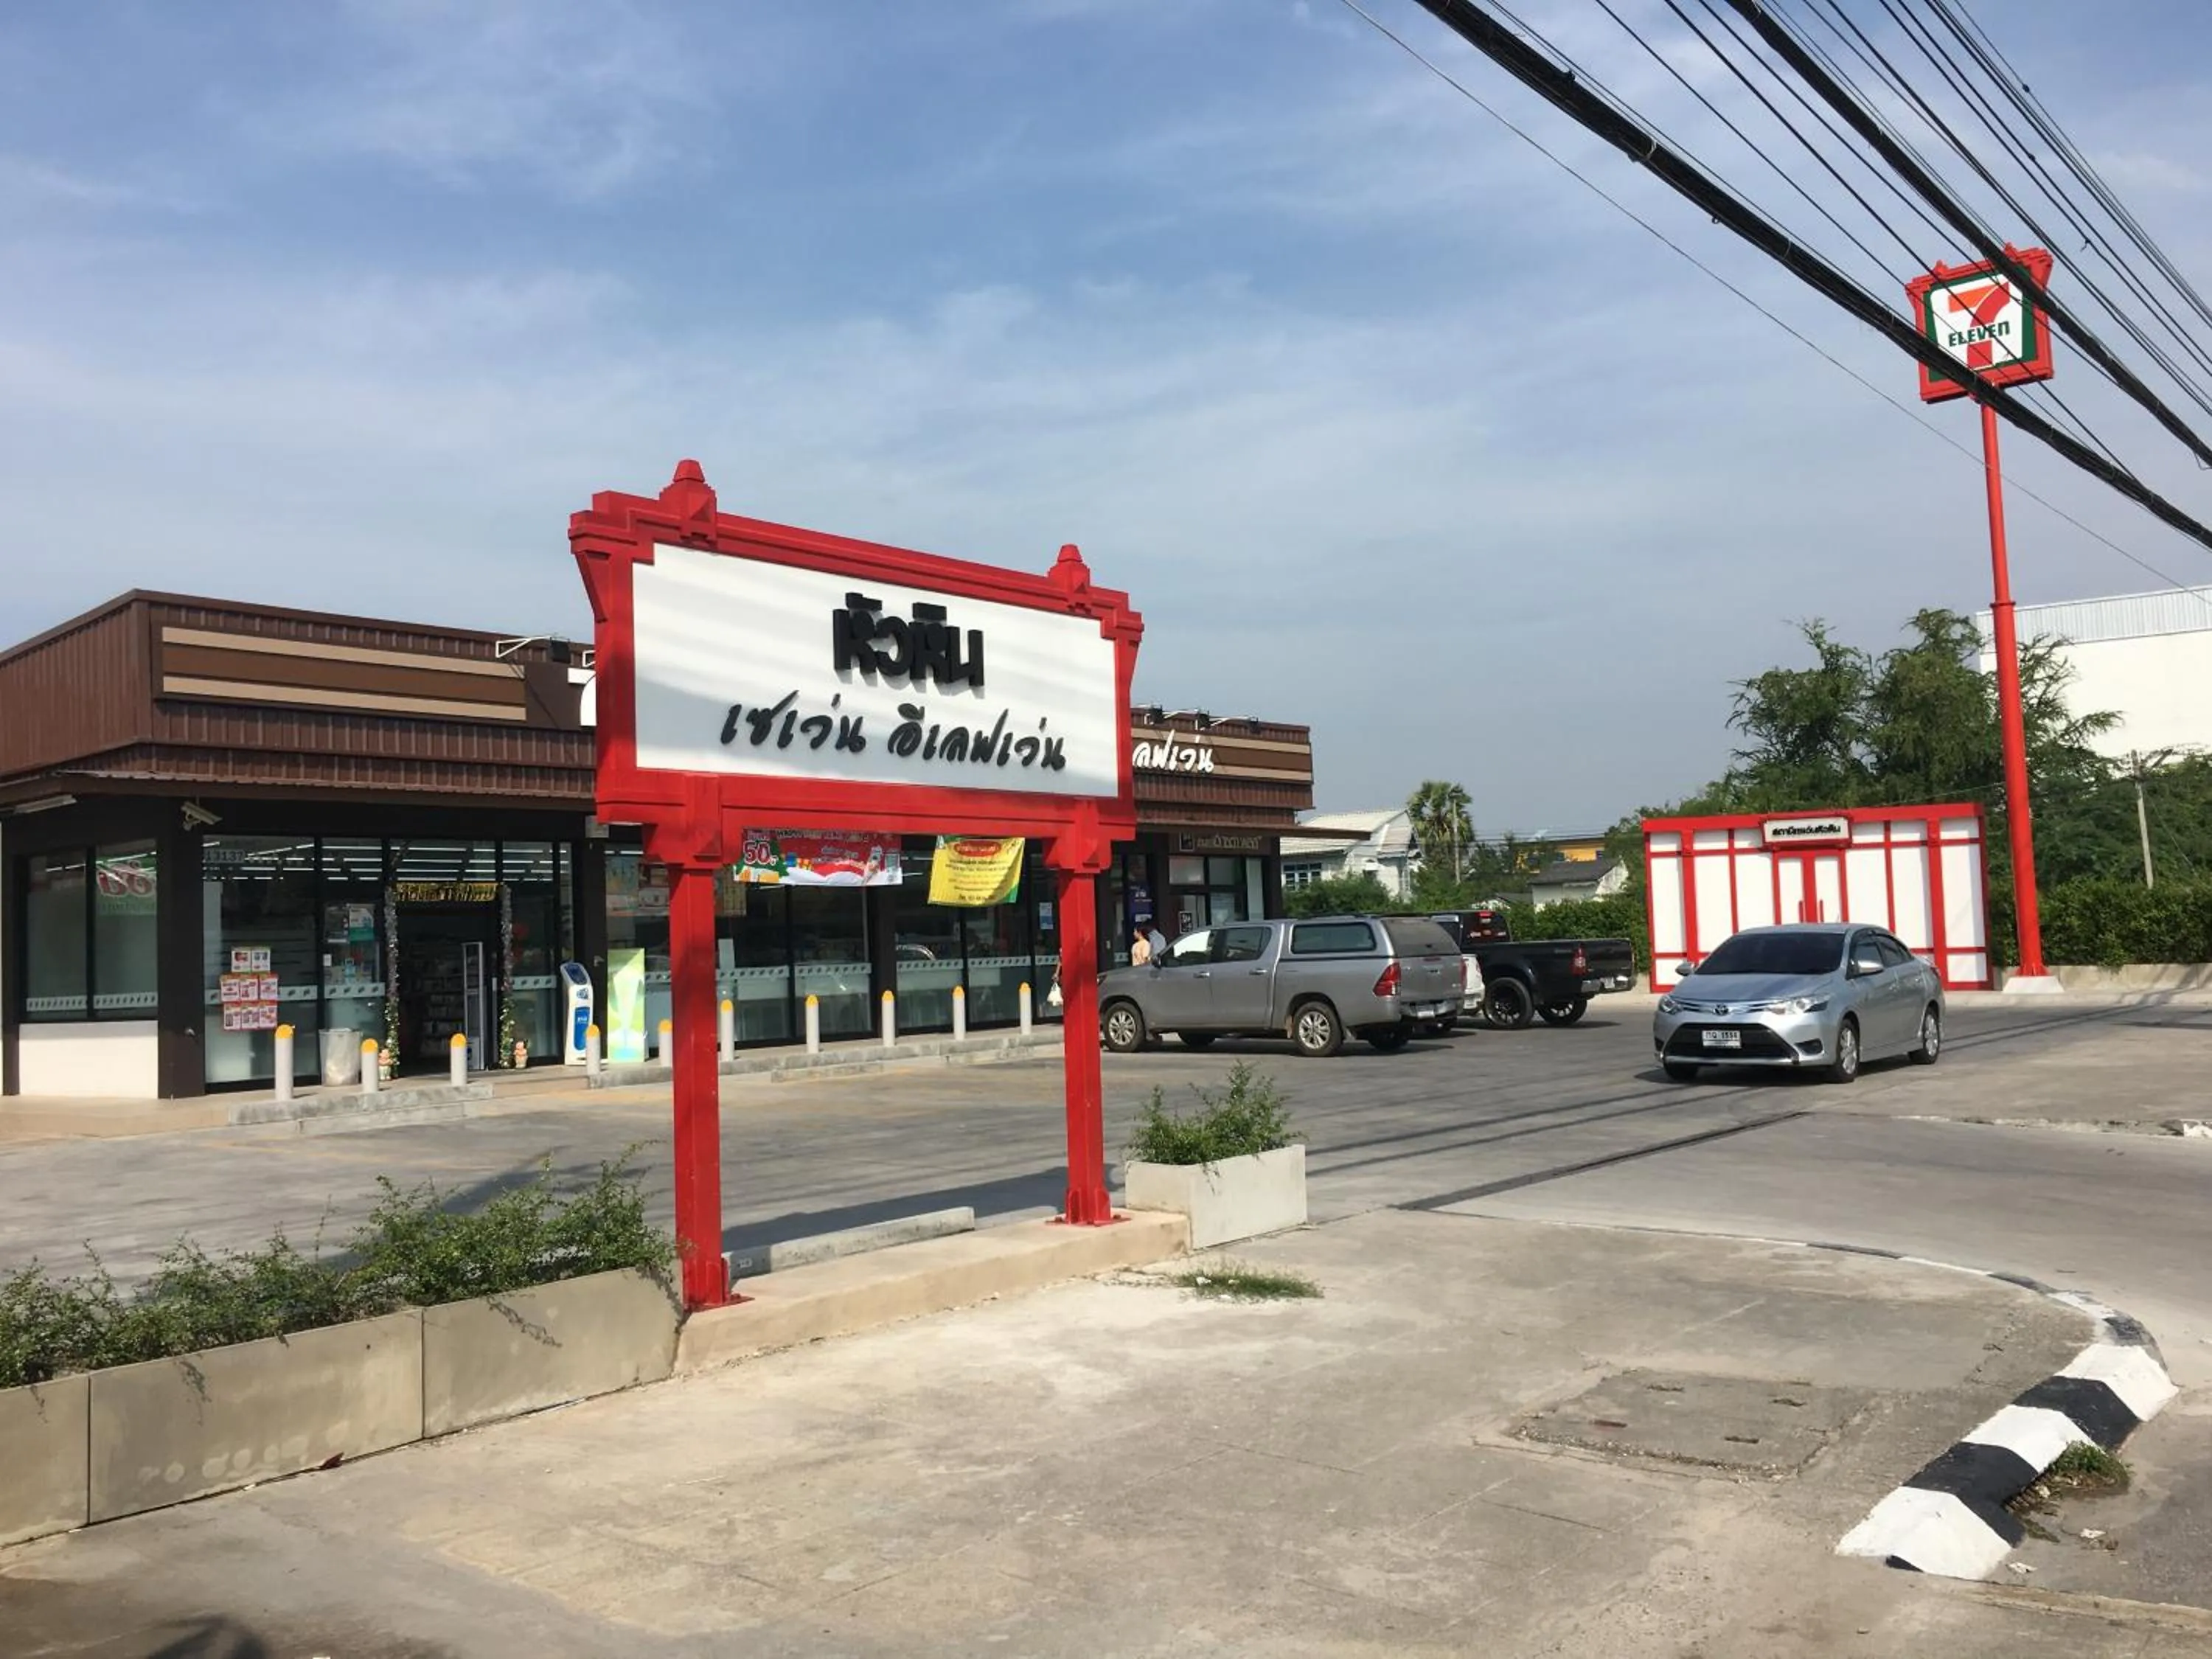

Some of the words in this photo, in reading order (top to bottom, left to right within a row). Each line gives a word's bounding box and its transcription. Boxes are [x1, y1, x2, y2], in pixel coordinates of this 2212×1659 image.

[832, 592, 984, 687] หัวหิน
[720, 689, 867, 753] เซเว่น
[887, 702, 1067, 771] อีเลฟเว่น
